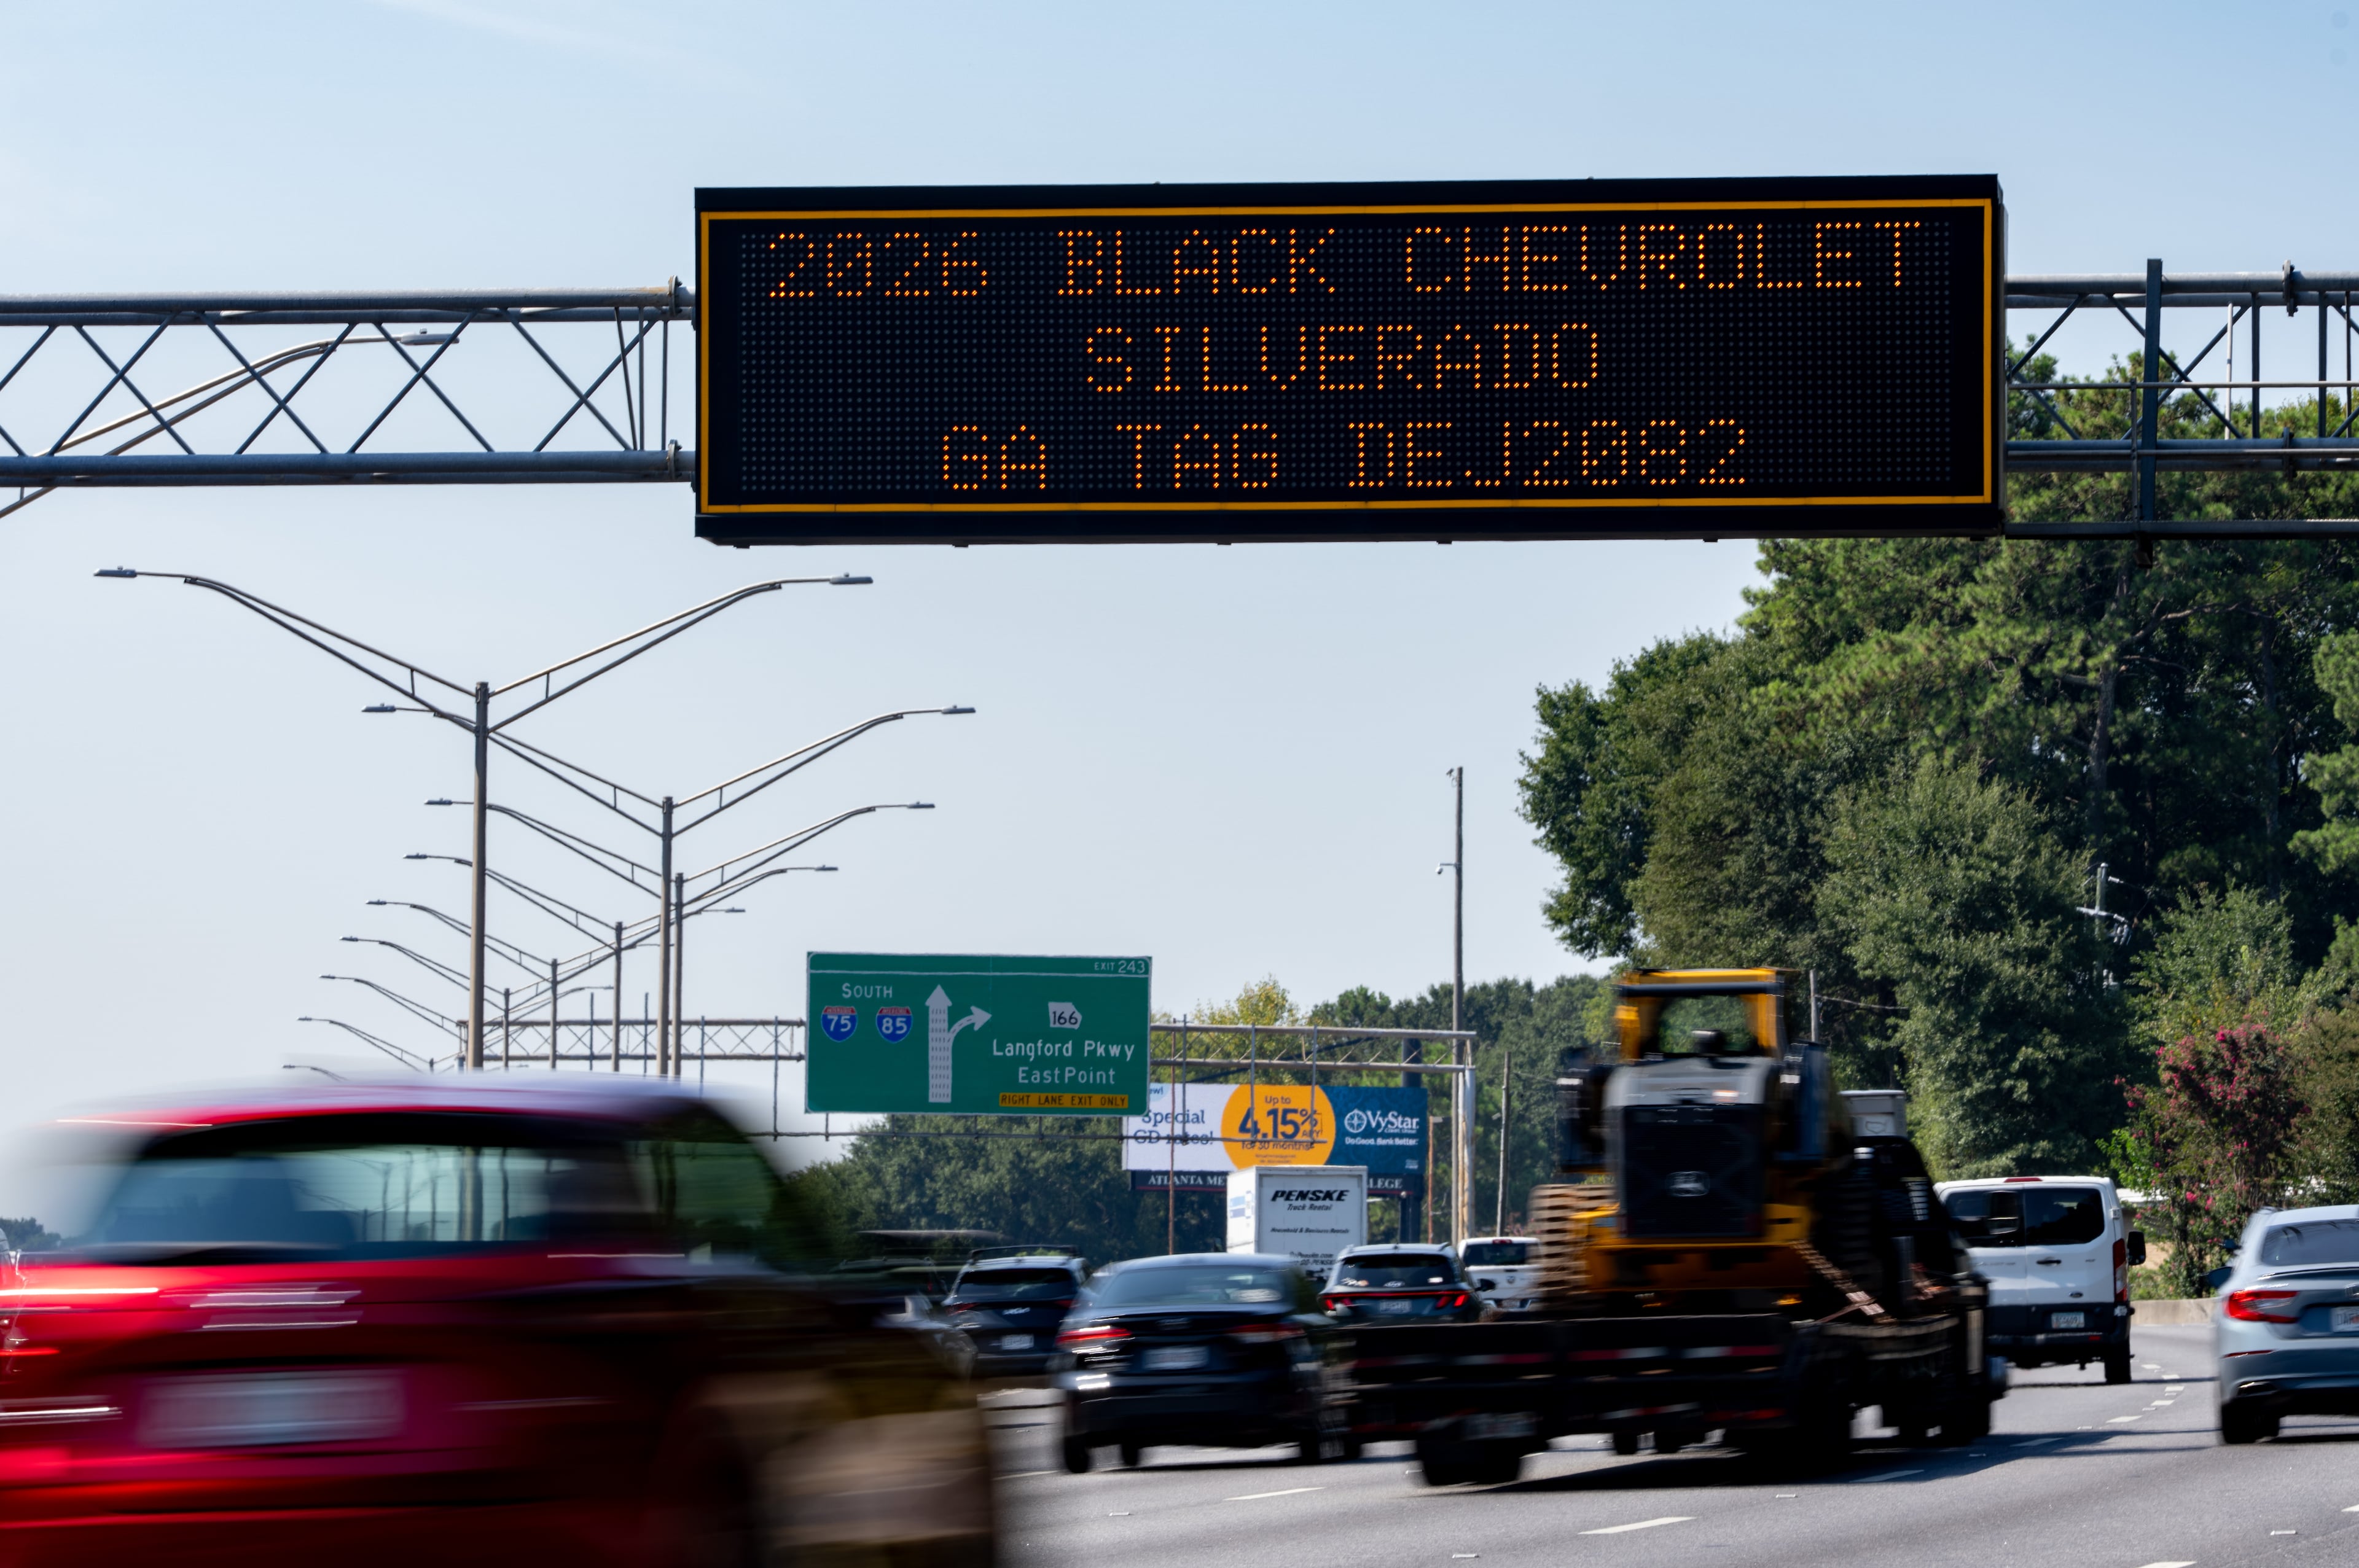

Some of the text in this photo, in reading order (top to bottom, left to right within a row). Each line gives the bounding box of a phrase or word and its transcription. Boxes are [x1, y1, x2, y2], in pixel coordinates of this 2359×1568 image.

[770, 221, 1920, 298] 2026 BLACK CHEVROLET
[1087, 323, 1597, 392] SILVERADO
[943, 419, 1745, 490] GA TAG DEJ2082
[1094, 961, 1145, 973] EXIT 243
[842, 983, 893, 998] SOUTH
[827, 1015, 851, 1032] 75
[882, 1017, 907, 1034] 85
[1052, 1010, 1078, 1025] 166
[993, 1039, 1135, 1061] Langford Pkwy
[1149, 1086, 1164, 1095] ew!
[1001, 1094, 1126, 1107] RIGHT LANE EXIT ONLY
[1265, 1096, 1291, 1106] Up to
[1142, 1109, 1205, 1127] Special
[1238, 1107, 1318, 1140] 4.15%
[1366, 1110, 1419, 1133] VyStar
[1133, 1129, 1214, 1145] CD raes!
[1148, 1174, 1203, 1186] ATLANTA
[1270, 1190, 1350, 1202] PENSKE
